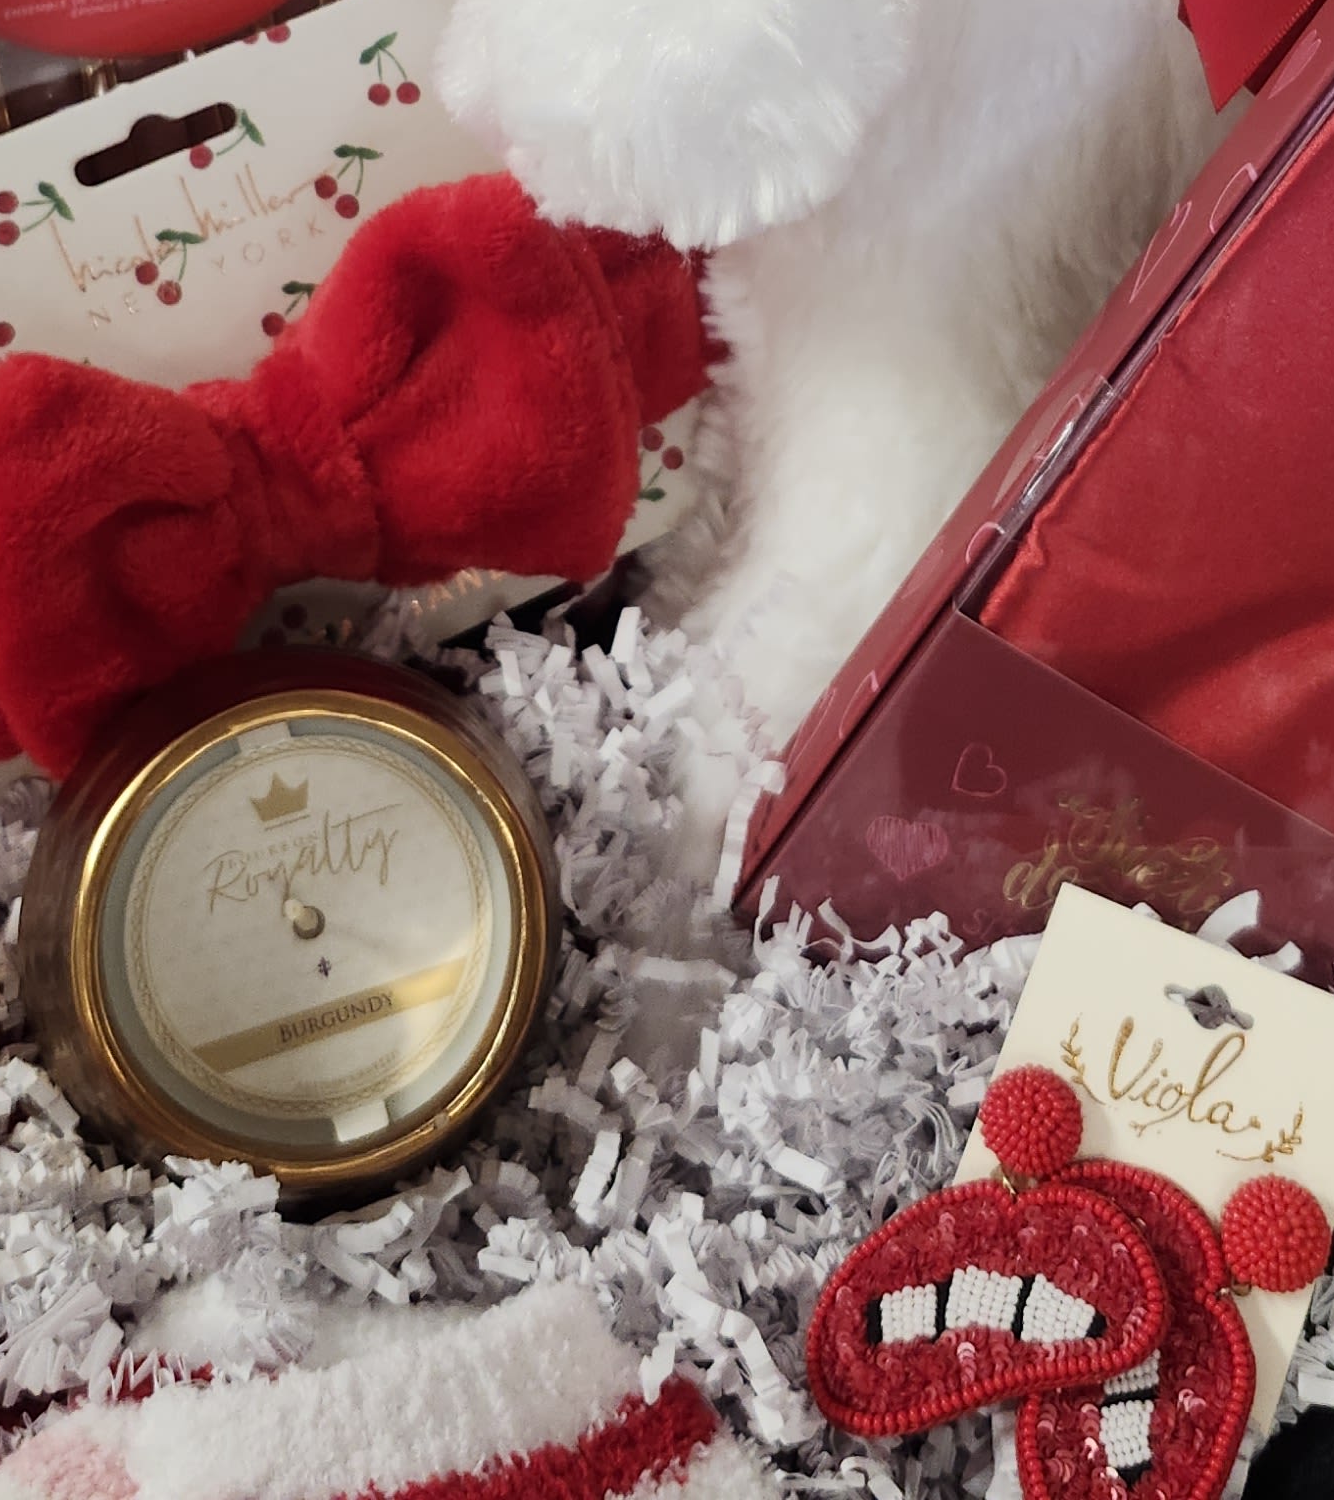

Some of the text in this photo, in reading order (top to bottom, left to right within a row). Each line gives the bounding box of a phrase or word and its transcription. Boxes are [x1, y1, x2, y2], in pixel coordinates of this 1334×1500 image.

[212, 215, 326, 276] YORK
[204, 803, 403, 916] Royalty
[277, 991, 396, 1045] BURGUNDY
[1107, 1016, 1262, 1135] Viola
